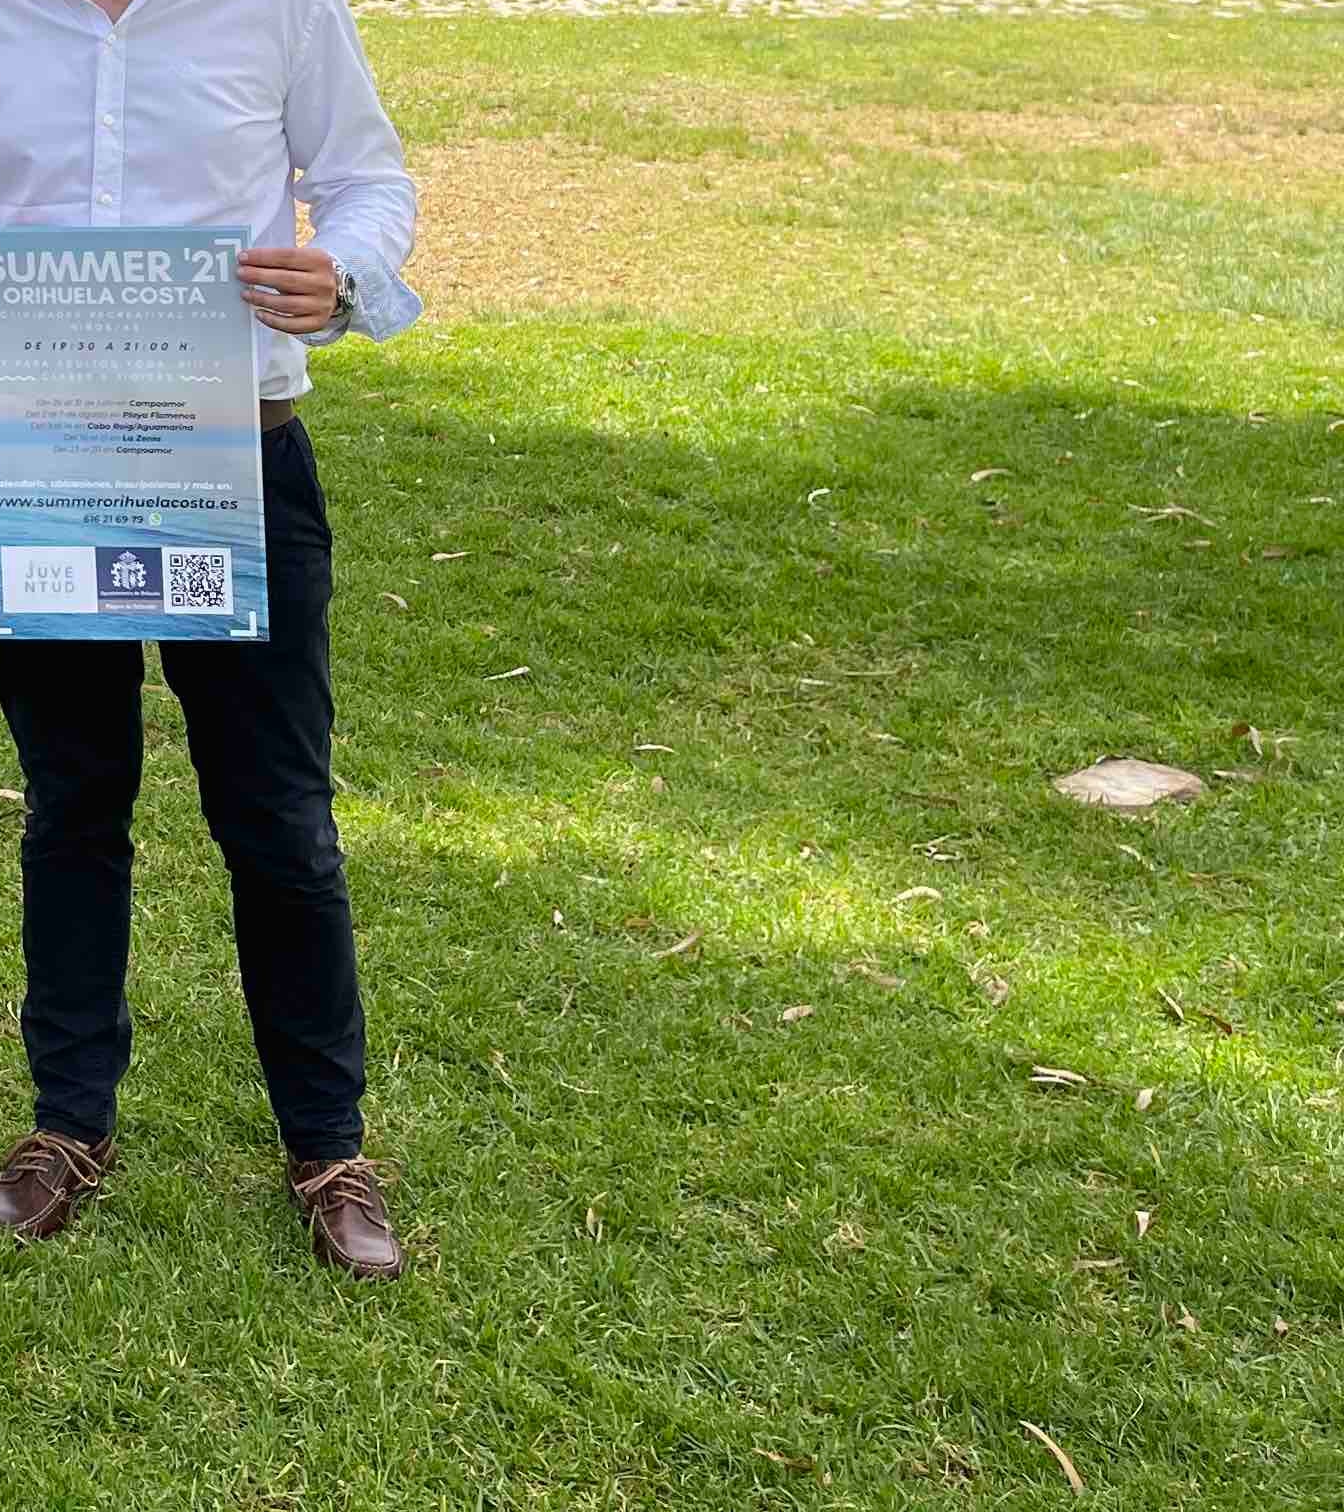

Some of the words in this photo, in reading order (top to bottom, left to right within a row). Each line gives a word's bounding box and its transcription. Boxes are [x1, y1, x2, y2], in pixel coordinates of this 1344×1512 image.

[183, 247, 229, 283] '21
[3, 287, 114, 305] ORIHUELA
[121, 287, 206, 305] COSTA
[24, 342, 41, 351] DE
